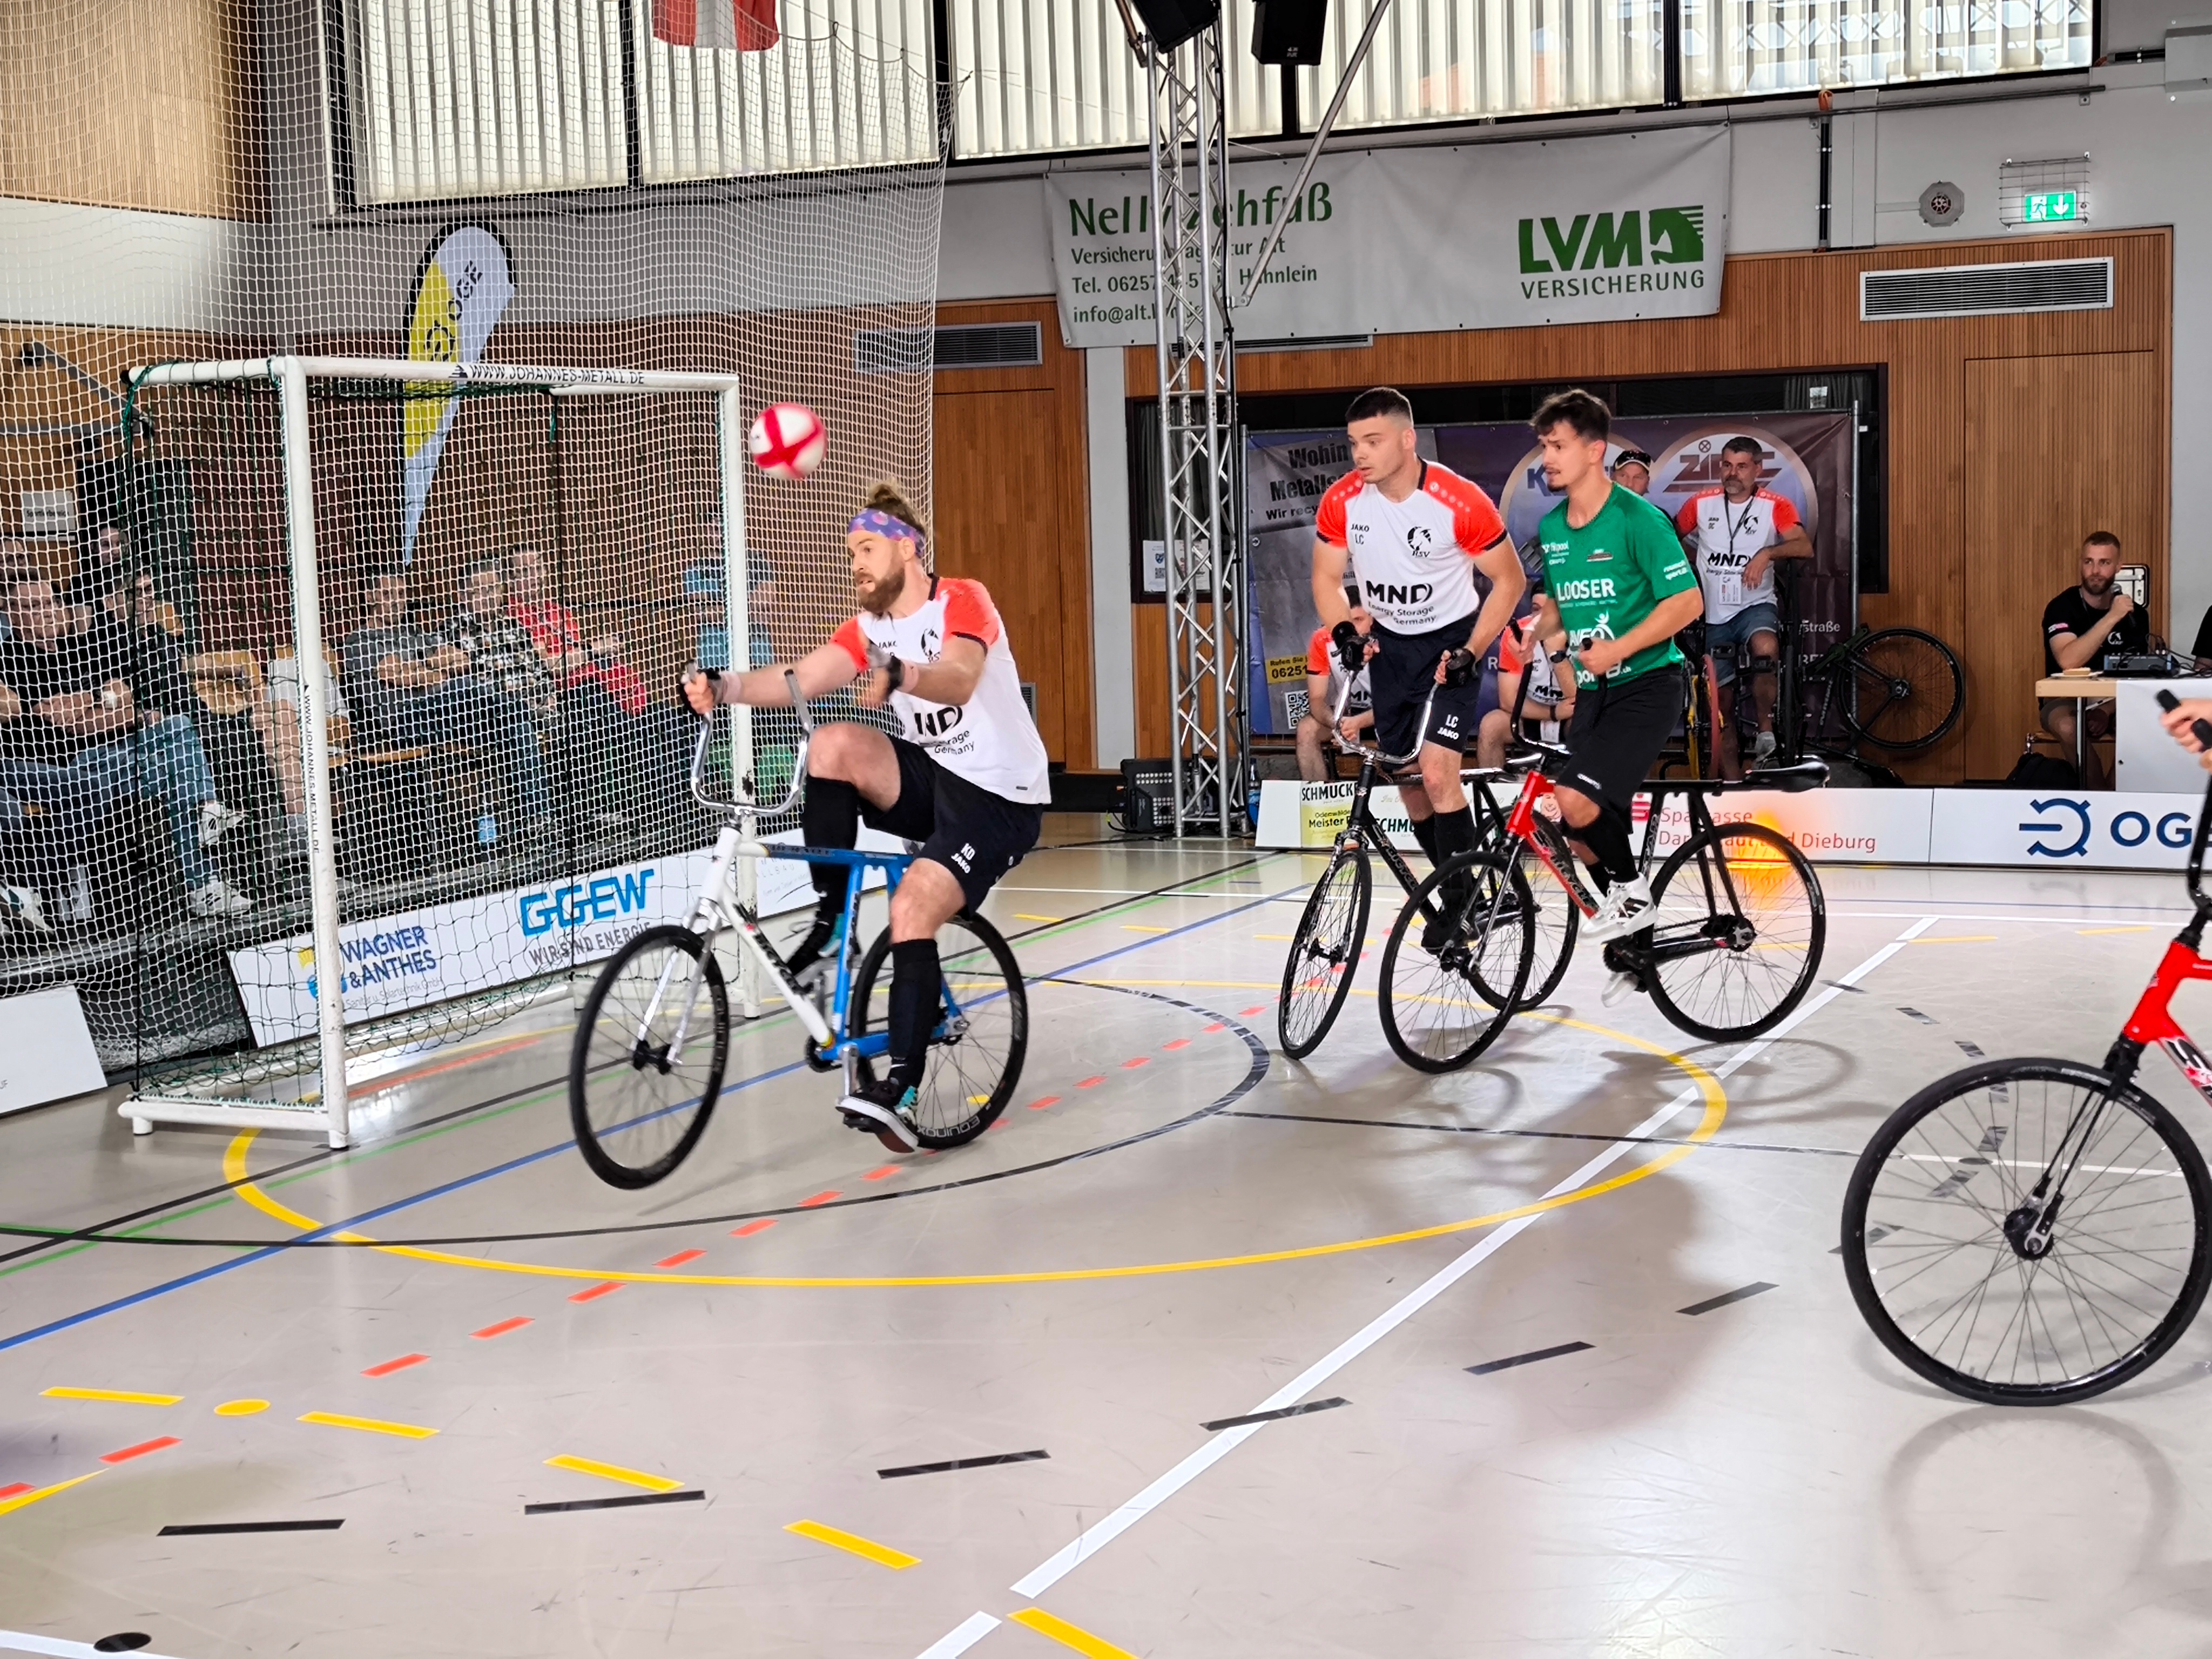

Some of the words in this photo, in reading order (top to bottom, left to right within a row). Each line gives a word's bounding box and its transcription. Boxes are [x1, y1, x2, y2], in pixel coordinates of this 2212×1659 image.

[1259, 236, 1286, 256] At
[1519, 210, 1643, 274] LVM
[1072, 276, 1101, 294] Tel.
[1239, 265, 1317, 286] Hhnlein
[1521, 269, 1704, 299] VERSICHERUNG
[469, 364, 645, 385] WWW.JOHANNES-METALL.DE
[1288, 443, 1349, 469] Wohin
[1266, 508, 1287, 520] Wir
[1291, 504, 1319, 516] recy
[1351, 523, 1370, 532] JAKO
[1708, 552, 1751, 568] MND
[1366, 580, 1433, 605] MND
[1556, 578, 1616, 602] LOOSER
[1397, 605, 1434, 617] Storage
[1270, 657, 1291, 666] Rufen
[1272, 665, 1308, 679] 06251
[914, 705, 963, 737] ND
[1445, 714, 1459, 729] LC
[1437, 727, 1460, 740] JAKO
[1309, 818, 1343, 828] Meister
[1660, 807, 1753, 825] Spaasse
[2110, 811, 2212, 848] OG
[1802, 833, 1876, 854] Dieburg
[951, 853, 970, 874] JAKO
[520, 868, 655, 936] GGEW
[341, 925, 429, 963] WAGNER
[529, 943, 563, 966] WIR
[562, 936, 594, 959] SIND
[917, 1115, 981, 1138] EQUINOX
